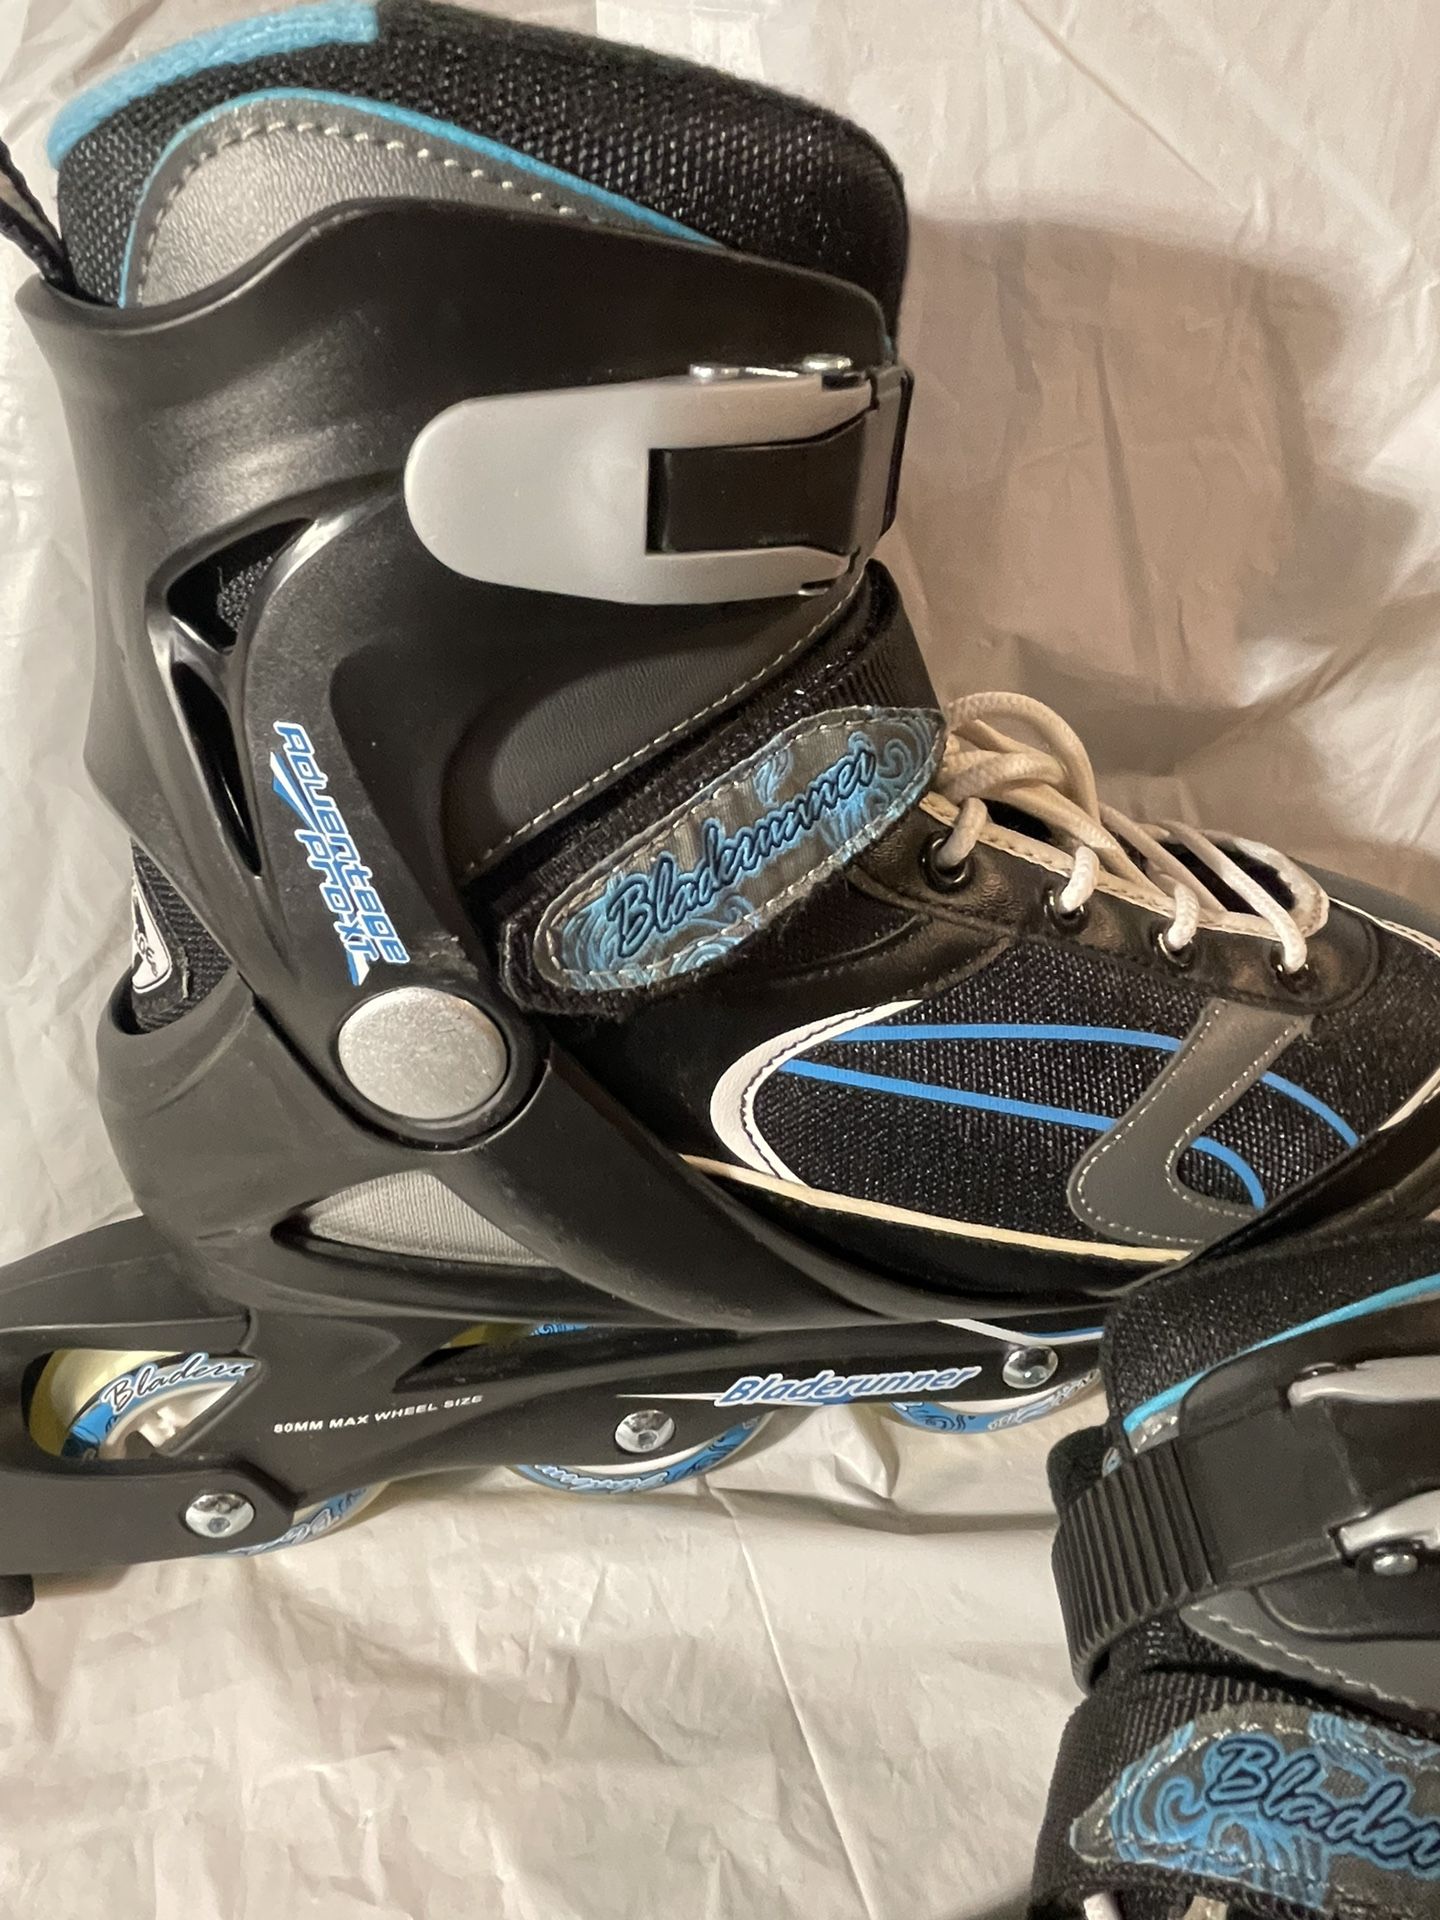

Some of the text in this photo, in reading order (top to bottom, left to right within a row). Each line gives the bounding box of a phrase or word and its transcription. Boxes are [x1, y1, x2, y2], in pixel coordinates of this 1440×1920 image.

[606, 743, 877, 960] Bladerunner
[714, 1366, 982, 1407] Bladerunner
[273, 1394, 484, 1434] 80MM MAX WHEEL SIZE
